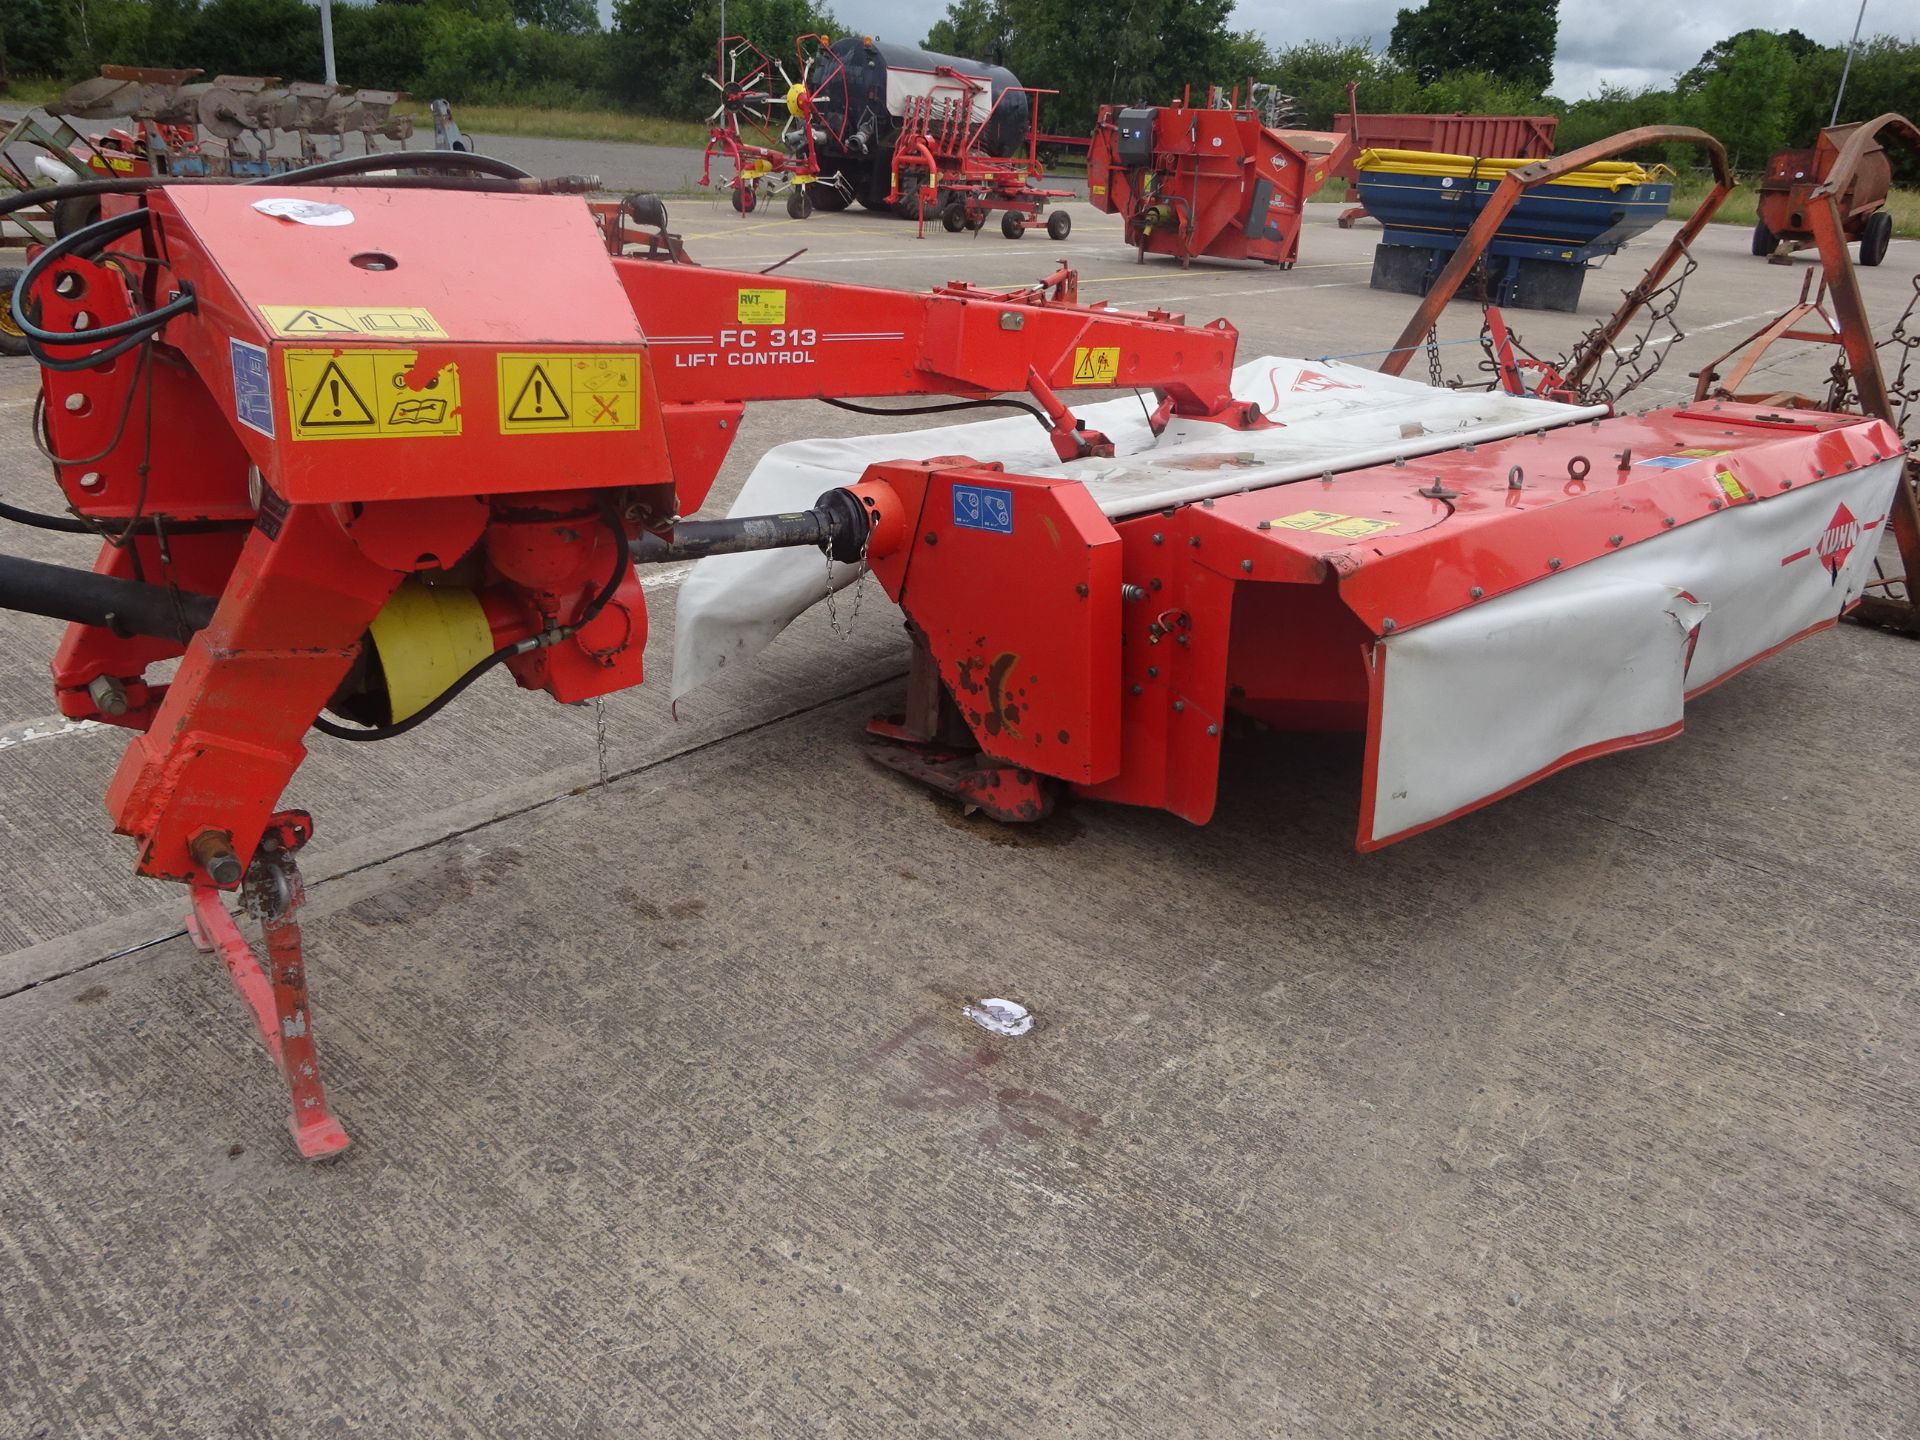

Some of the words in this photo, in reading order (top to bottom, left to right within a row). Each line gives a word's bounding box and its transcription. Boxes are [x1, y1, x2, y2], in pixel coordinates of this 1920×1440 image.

[740, 294, 760, 305] RVT
[720, 330, 756, 348] FC
[770, 329, 817, 347] 313
[675, 353, 718, 367] LIFT
[727, 351, 815, 366] CONTROL
[1821, 520, 1857, 556] KUHN
